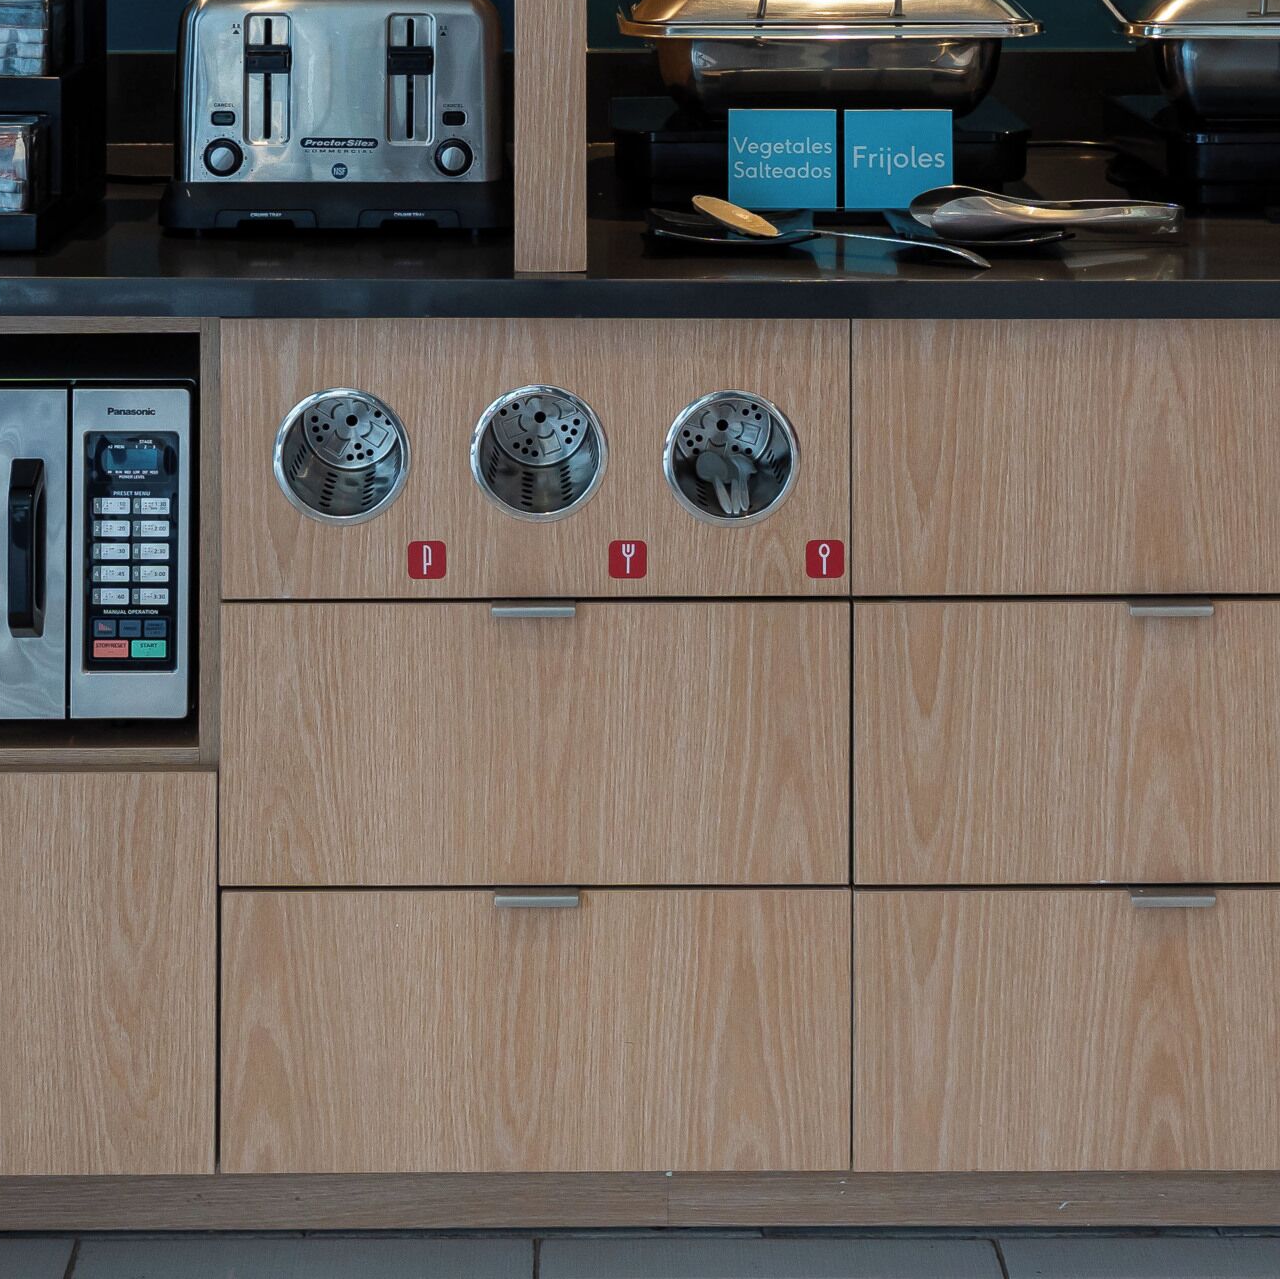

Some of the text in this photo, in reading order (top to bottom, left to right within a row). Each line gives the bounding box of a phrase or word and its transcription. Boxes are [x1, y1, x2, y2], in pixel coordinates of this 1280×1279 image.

[733, 136, 832, 159] Vegetales
[733, 161, 832, 179] Salteados
[853, 146, 945, 176] Frijoles
[333, 167, 347, 176] NSF
[107, 407, 156, 416] Panasonic
